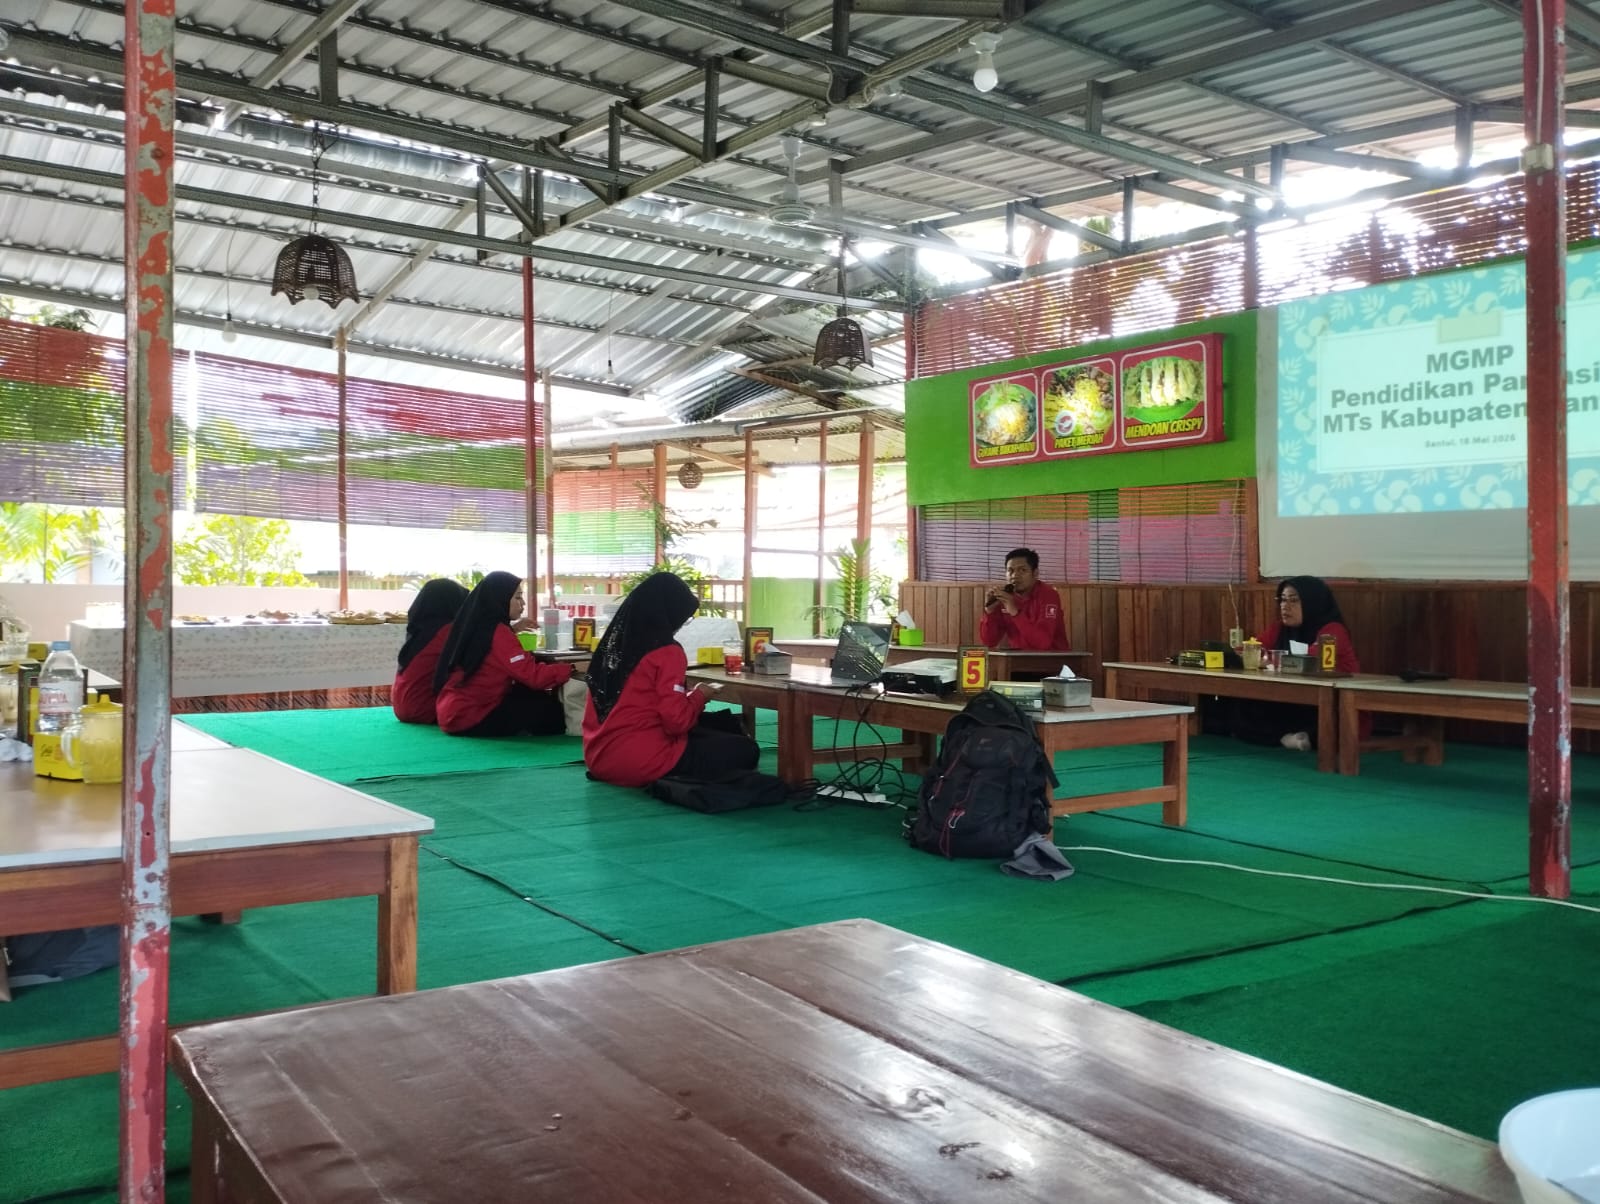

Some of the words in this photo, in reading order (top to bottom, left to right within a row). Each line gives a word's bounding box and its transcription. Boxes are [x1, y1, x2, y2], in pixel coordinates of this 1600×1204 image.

[1426, 345, 1514, 373] MGMP
[1331, 380, 1473, 408] Pendidikan
[1125, 422, 1169, 439] MENDOAN
[1170, 417, 1204, 433] CRISPY
[1323, 412, 1373, 433] MTs
[1381, 400, 1527, 429] Kabupaten
[578, 627, 588, 642] 7
[1325, 647, 1333, 665] 2
[967, 660, 980, 685] 5
